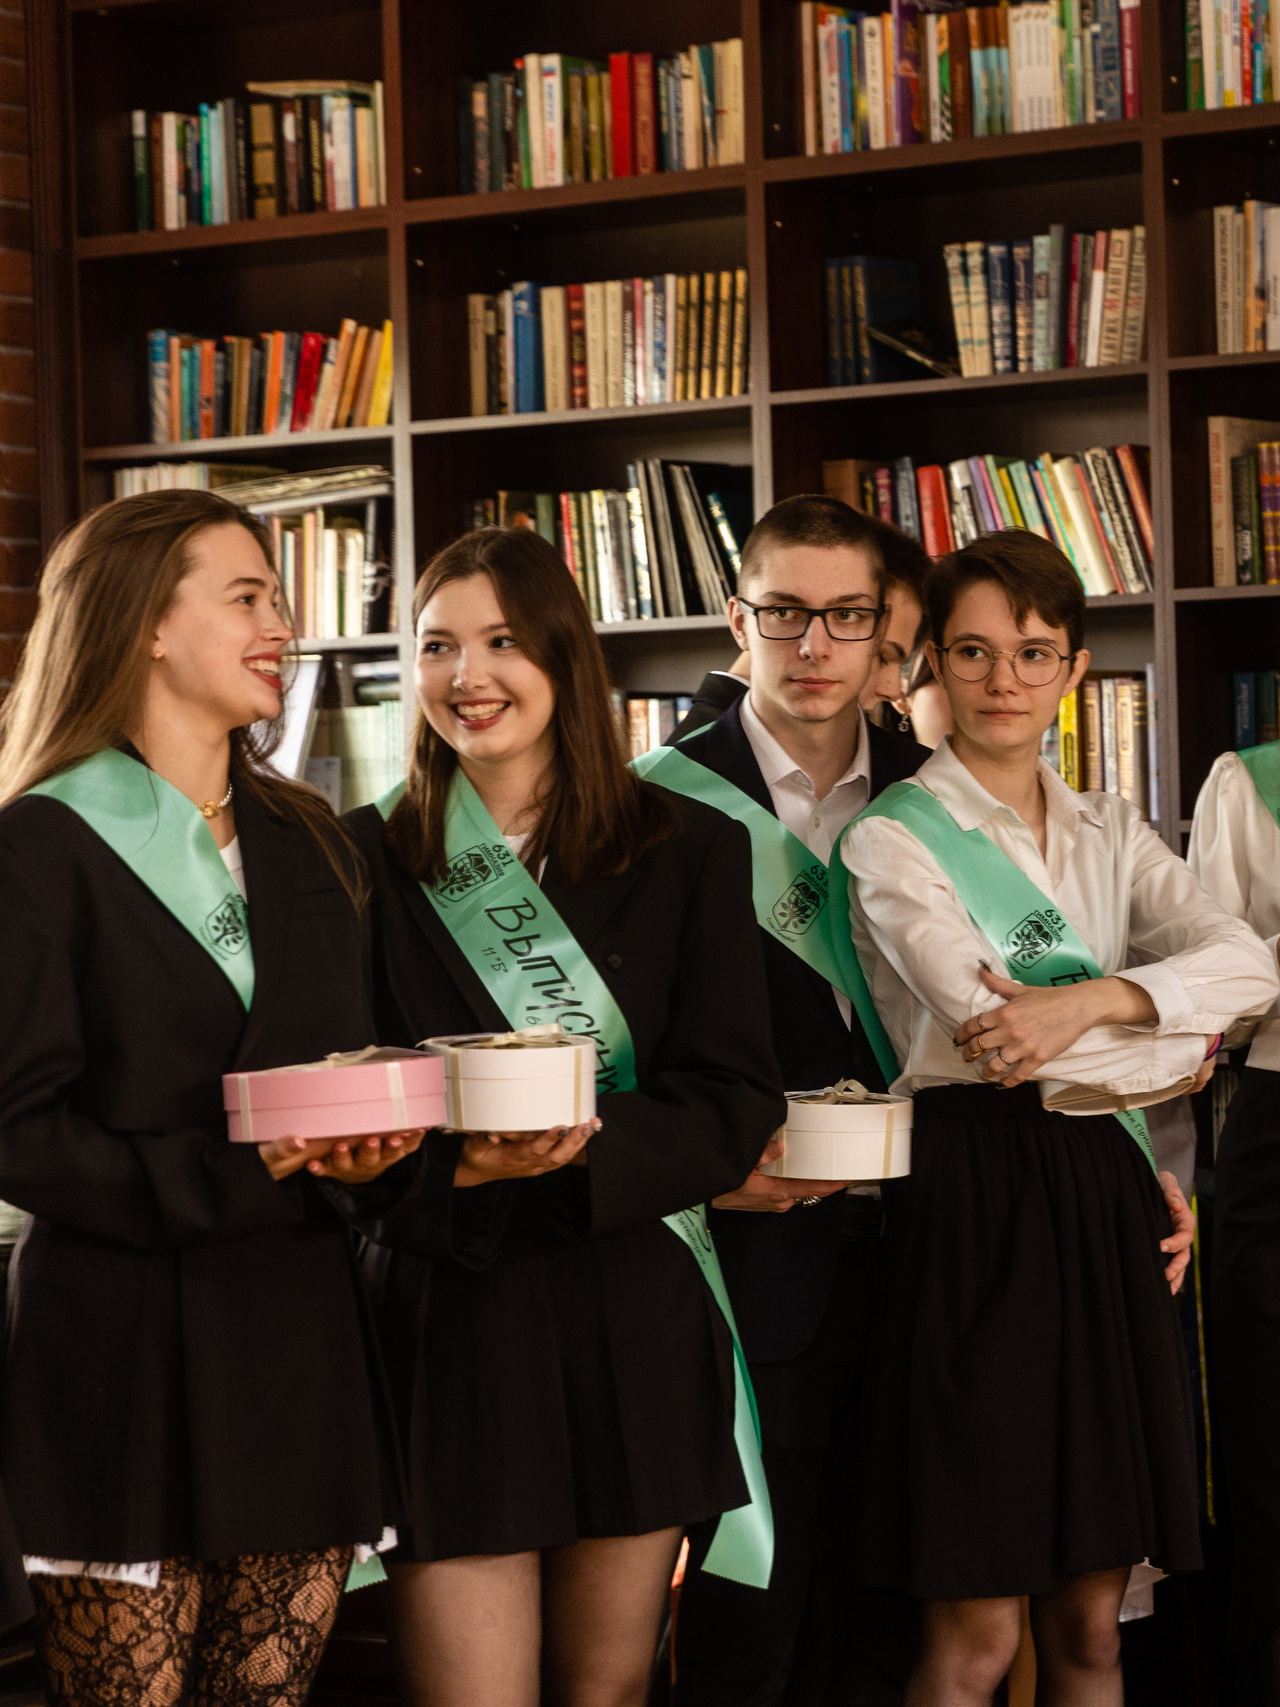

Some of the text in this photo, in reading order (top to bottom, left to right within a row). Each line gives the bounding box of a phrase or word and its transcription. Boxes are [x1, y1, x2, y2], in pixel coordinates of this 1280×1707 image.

[479, 842, 506, 877] ГИМНАЗИЯ
[492, 844, 515, 867] 631
[800, 868, 829, 899] ГИМНАЗИЯ
[809, 864, 829, 888] 631
[1033, 909, 1064, 942] ГИМНАЗИЯ
[1044, 909, 1067, 933] 631
